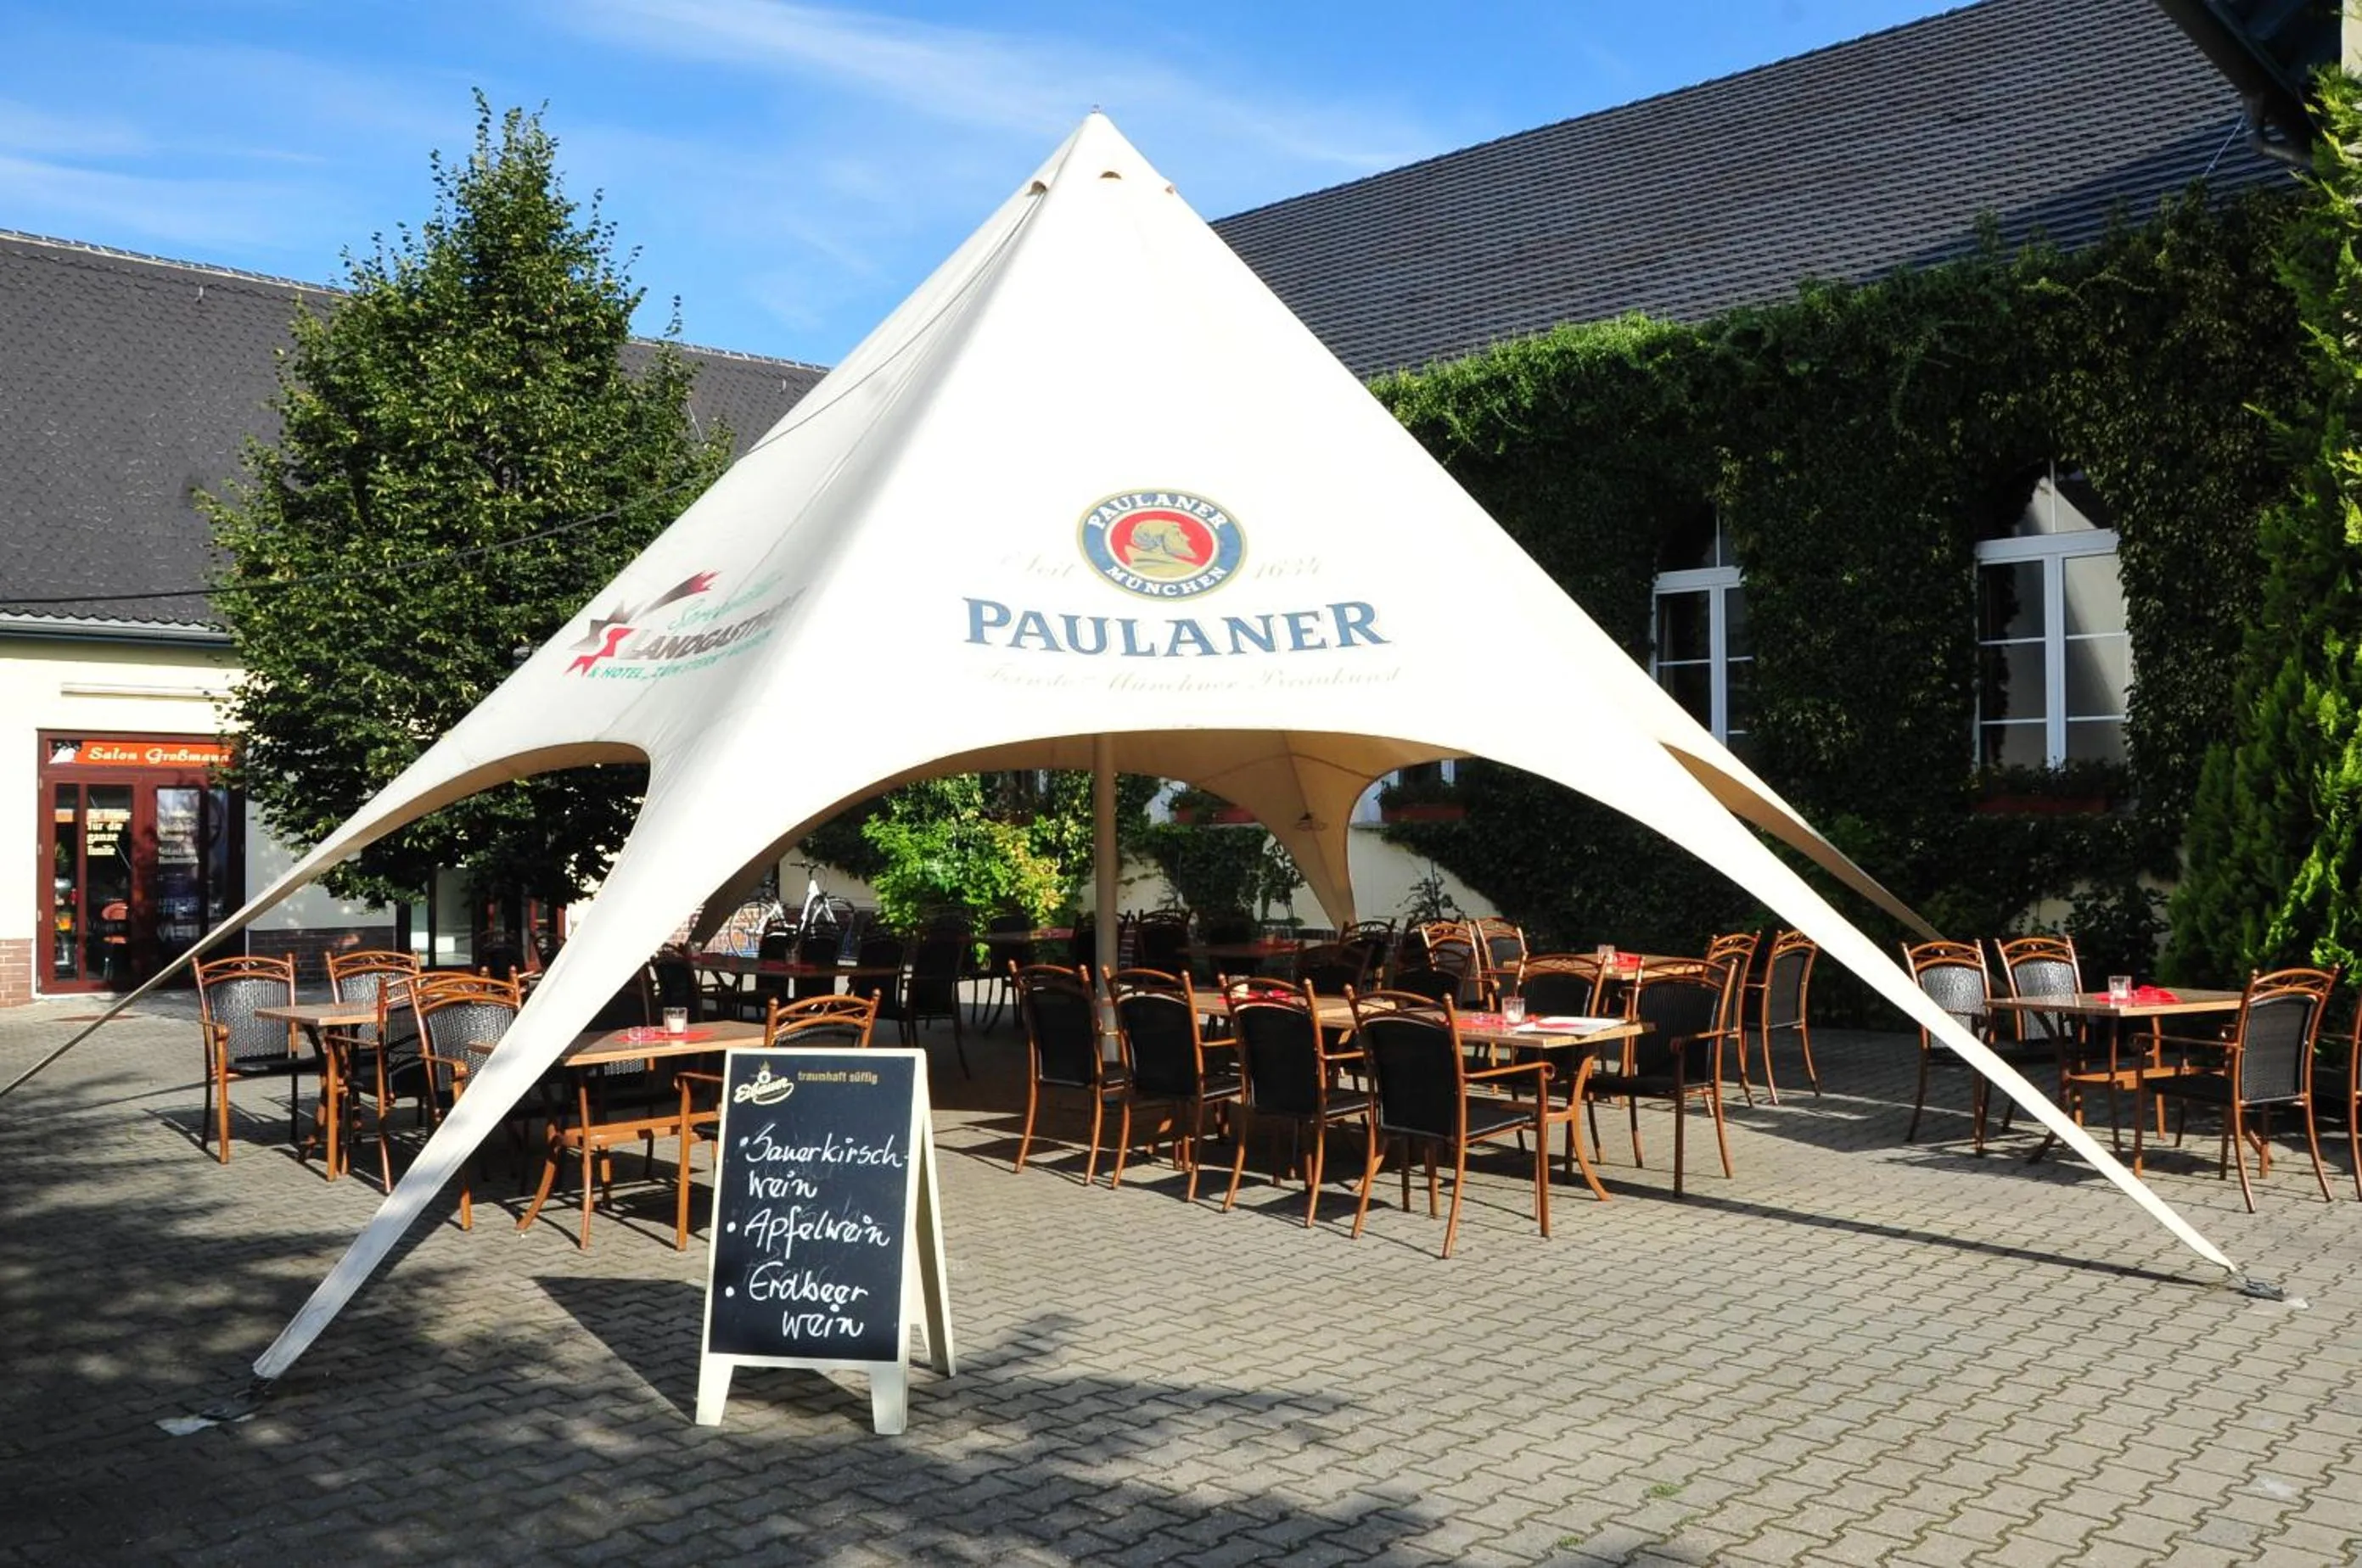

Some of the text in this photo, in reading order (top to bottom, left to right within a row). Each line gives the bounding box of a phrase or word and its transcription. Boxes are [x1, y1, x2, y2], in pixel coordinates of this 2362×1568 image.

[1087, 493, 1228, 529] PAULANER
[962, 596, 1393, 658] PAULANER
[88, 747, 230, 764] Salon Großmann
[798, 1071, 878, 1085] traumhaft süffig
[744, 1206, 891, 1260] Apfelwein
[749, 1261, 869, 1305] Erdbeer
